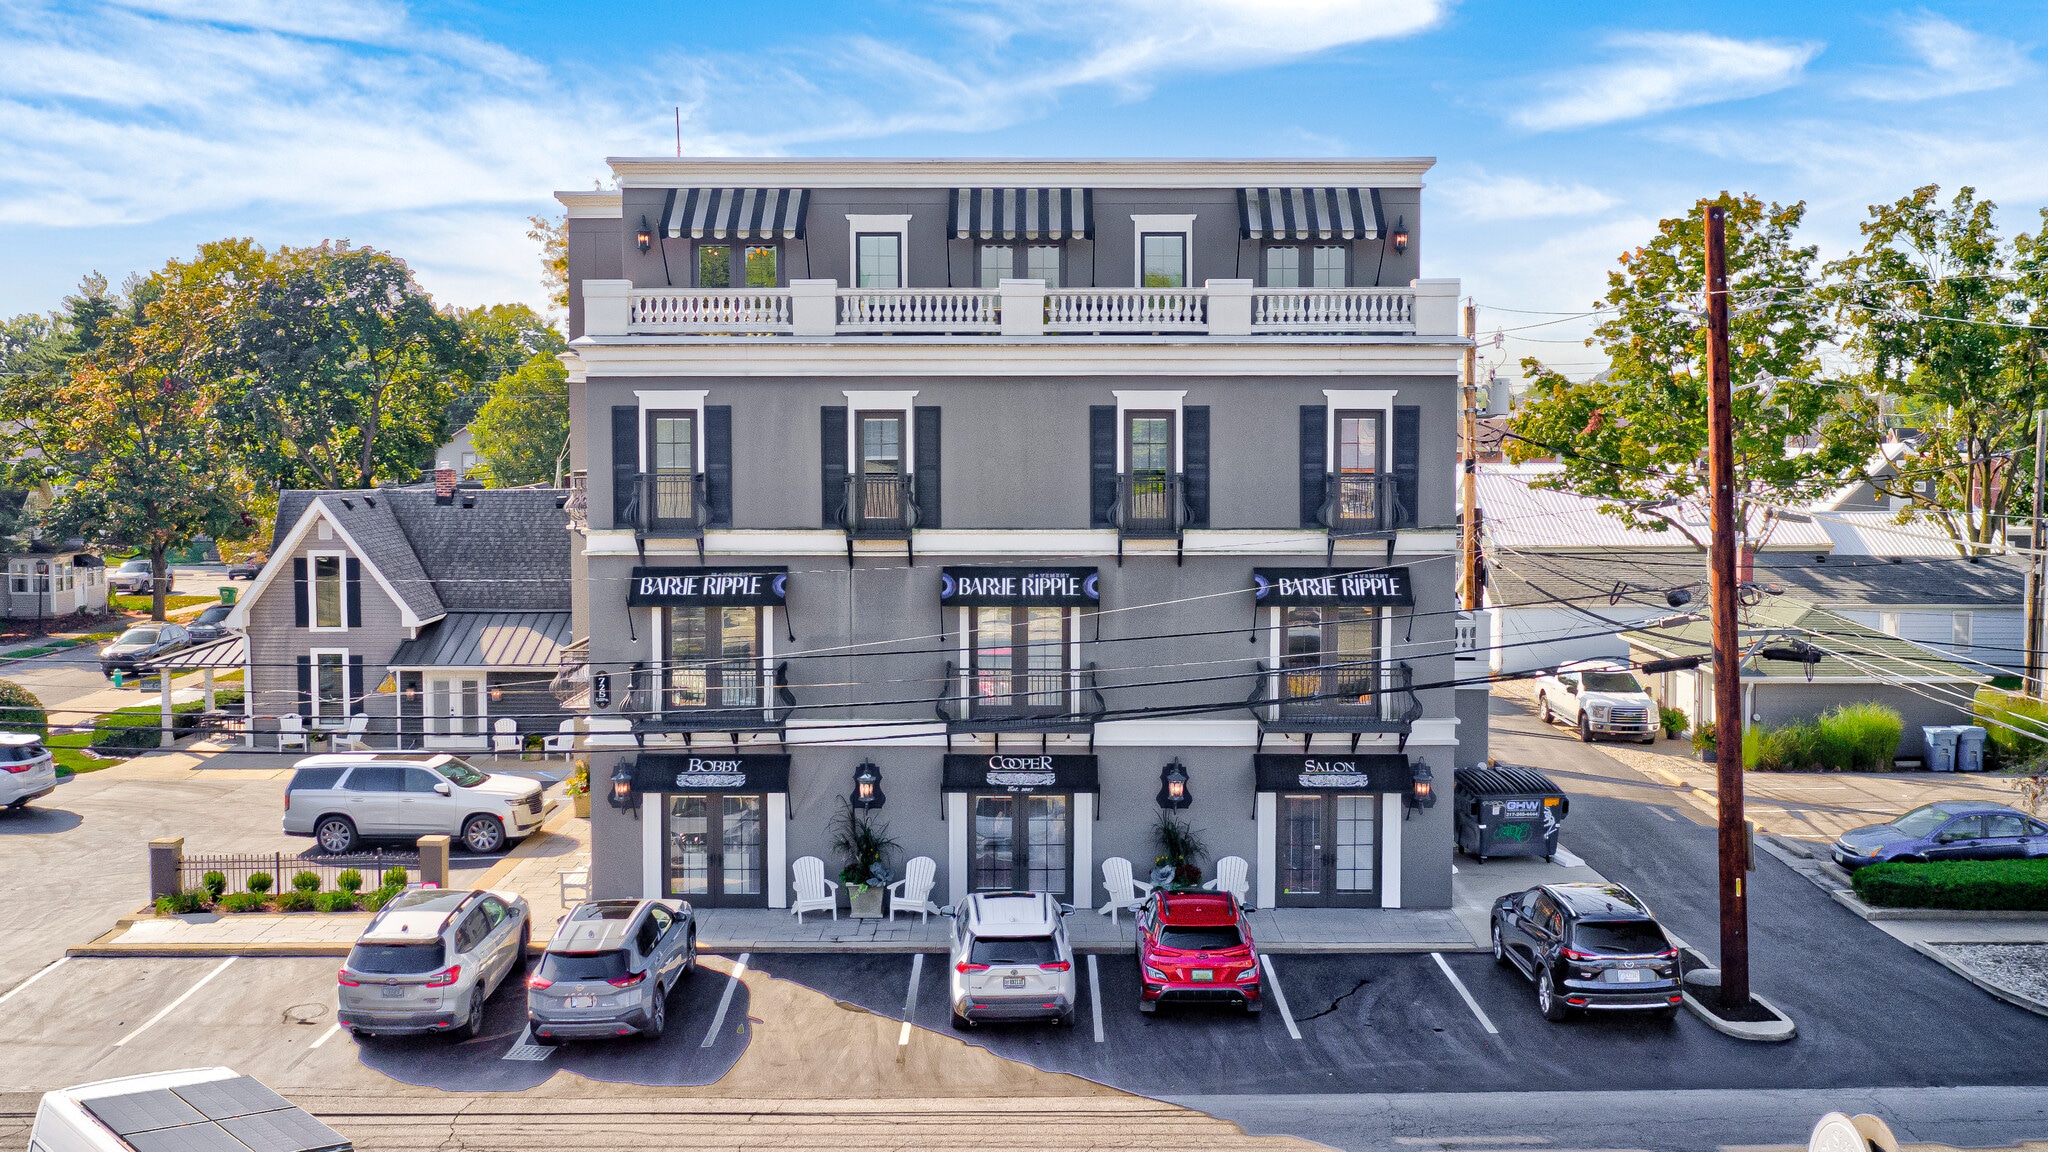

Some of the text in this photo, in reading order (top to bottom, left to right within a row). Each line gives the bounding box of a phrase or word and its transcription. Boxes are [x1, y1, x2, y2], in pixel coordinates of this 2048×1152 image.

[703, 576, 762, 595] RIPPLE
[1022, 577, 1081, 596] RIPPLE
[1342, 577, 1402, 596] RIPPLE
[689, 758, 742, 772] BOBBY
[989, 755, 1053, 770] COOPER
[1304, 759, 1356, 772] SALON
[1507, 801, 1539, 810] GHW
